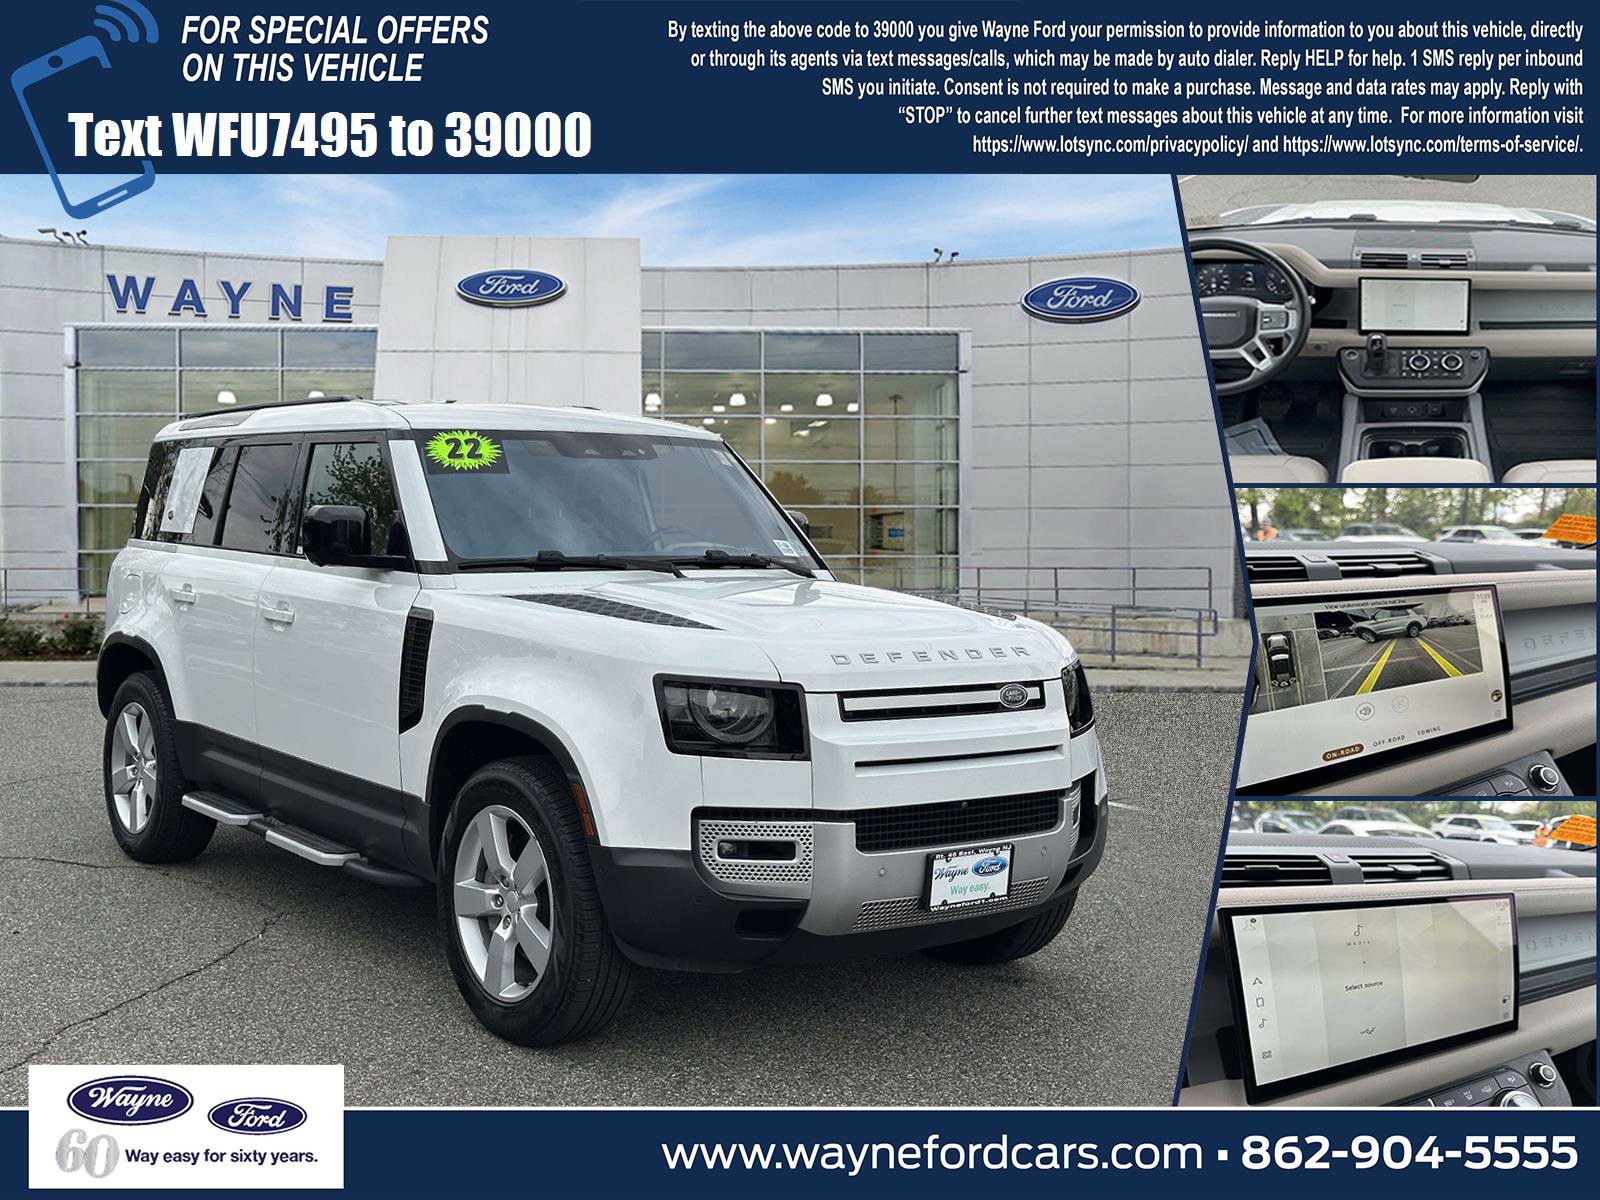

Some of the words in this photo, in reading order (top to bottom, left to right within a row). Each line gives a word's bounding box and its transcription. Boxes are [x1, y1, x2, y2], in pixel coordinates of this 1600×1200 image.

[479, 274, 540, 295] Ford
[106, 274, 353, 321] WAYNE
[1046, 284, 1114, 309] Ford
[445, 438, 483, 459] 22
[831, 646, 1031, 666] DEFENDER
[1326, 746, 1360, 760] ON-ROAD
[1373, 735, 1406, 747] OFF-ROAD
[934, 865, 968, 883] Wayne
[979, 858, 1002, 873] Ford
[950, 885, 968, 896] Way
[1345, 983, 1363, 991] Select
